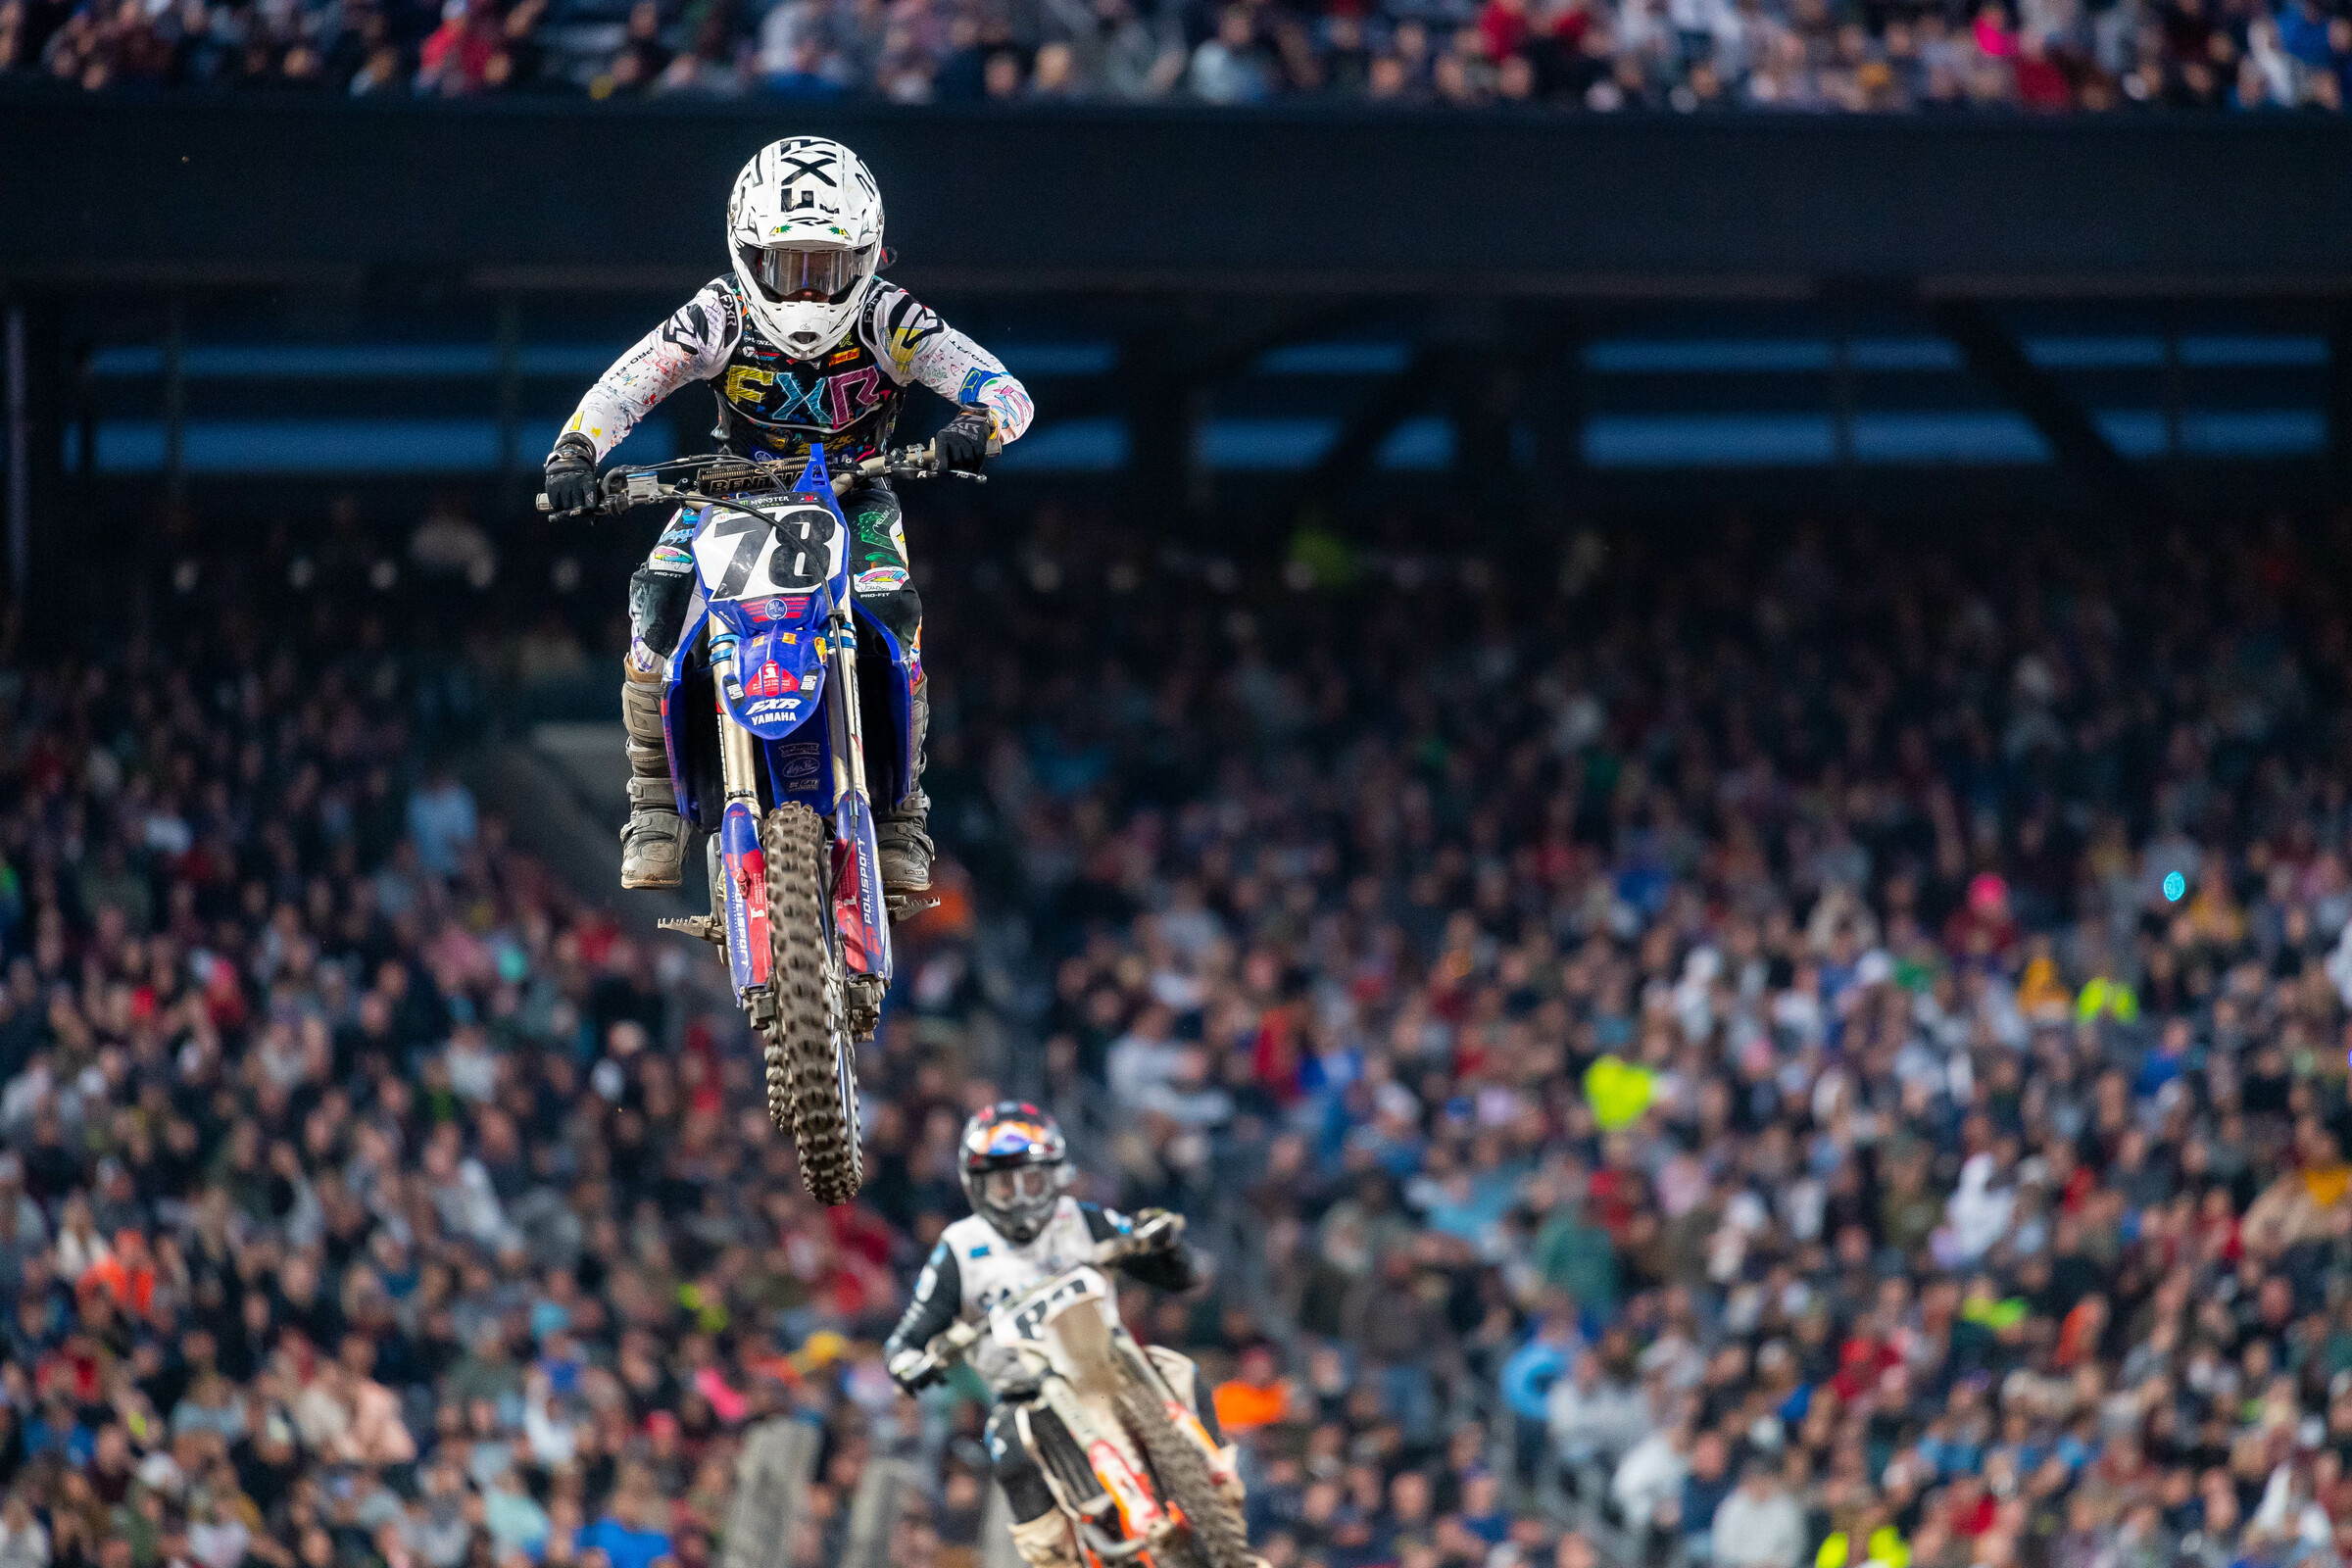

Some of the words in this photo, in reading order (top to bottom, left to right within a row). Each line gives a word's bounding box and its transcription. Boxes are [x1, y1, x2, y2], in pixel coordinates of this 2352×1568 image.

[719, 294, 738, 326] FXR
[726, 364, 881, 427] FXR
[750, 495, 790, 506] MONSTER
[711, 510, 836, 599] 78
[745, 698, 802, 716] FXR
[751, 711, 797, 726] YAMAHA
[857, 837, 873, 925] POLISPORT
